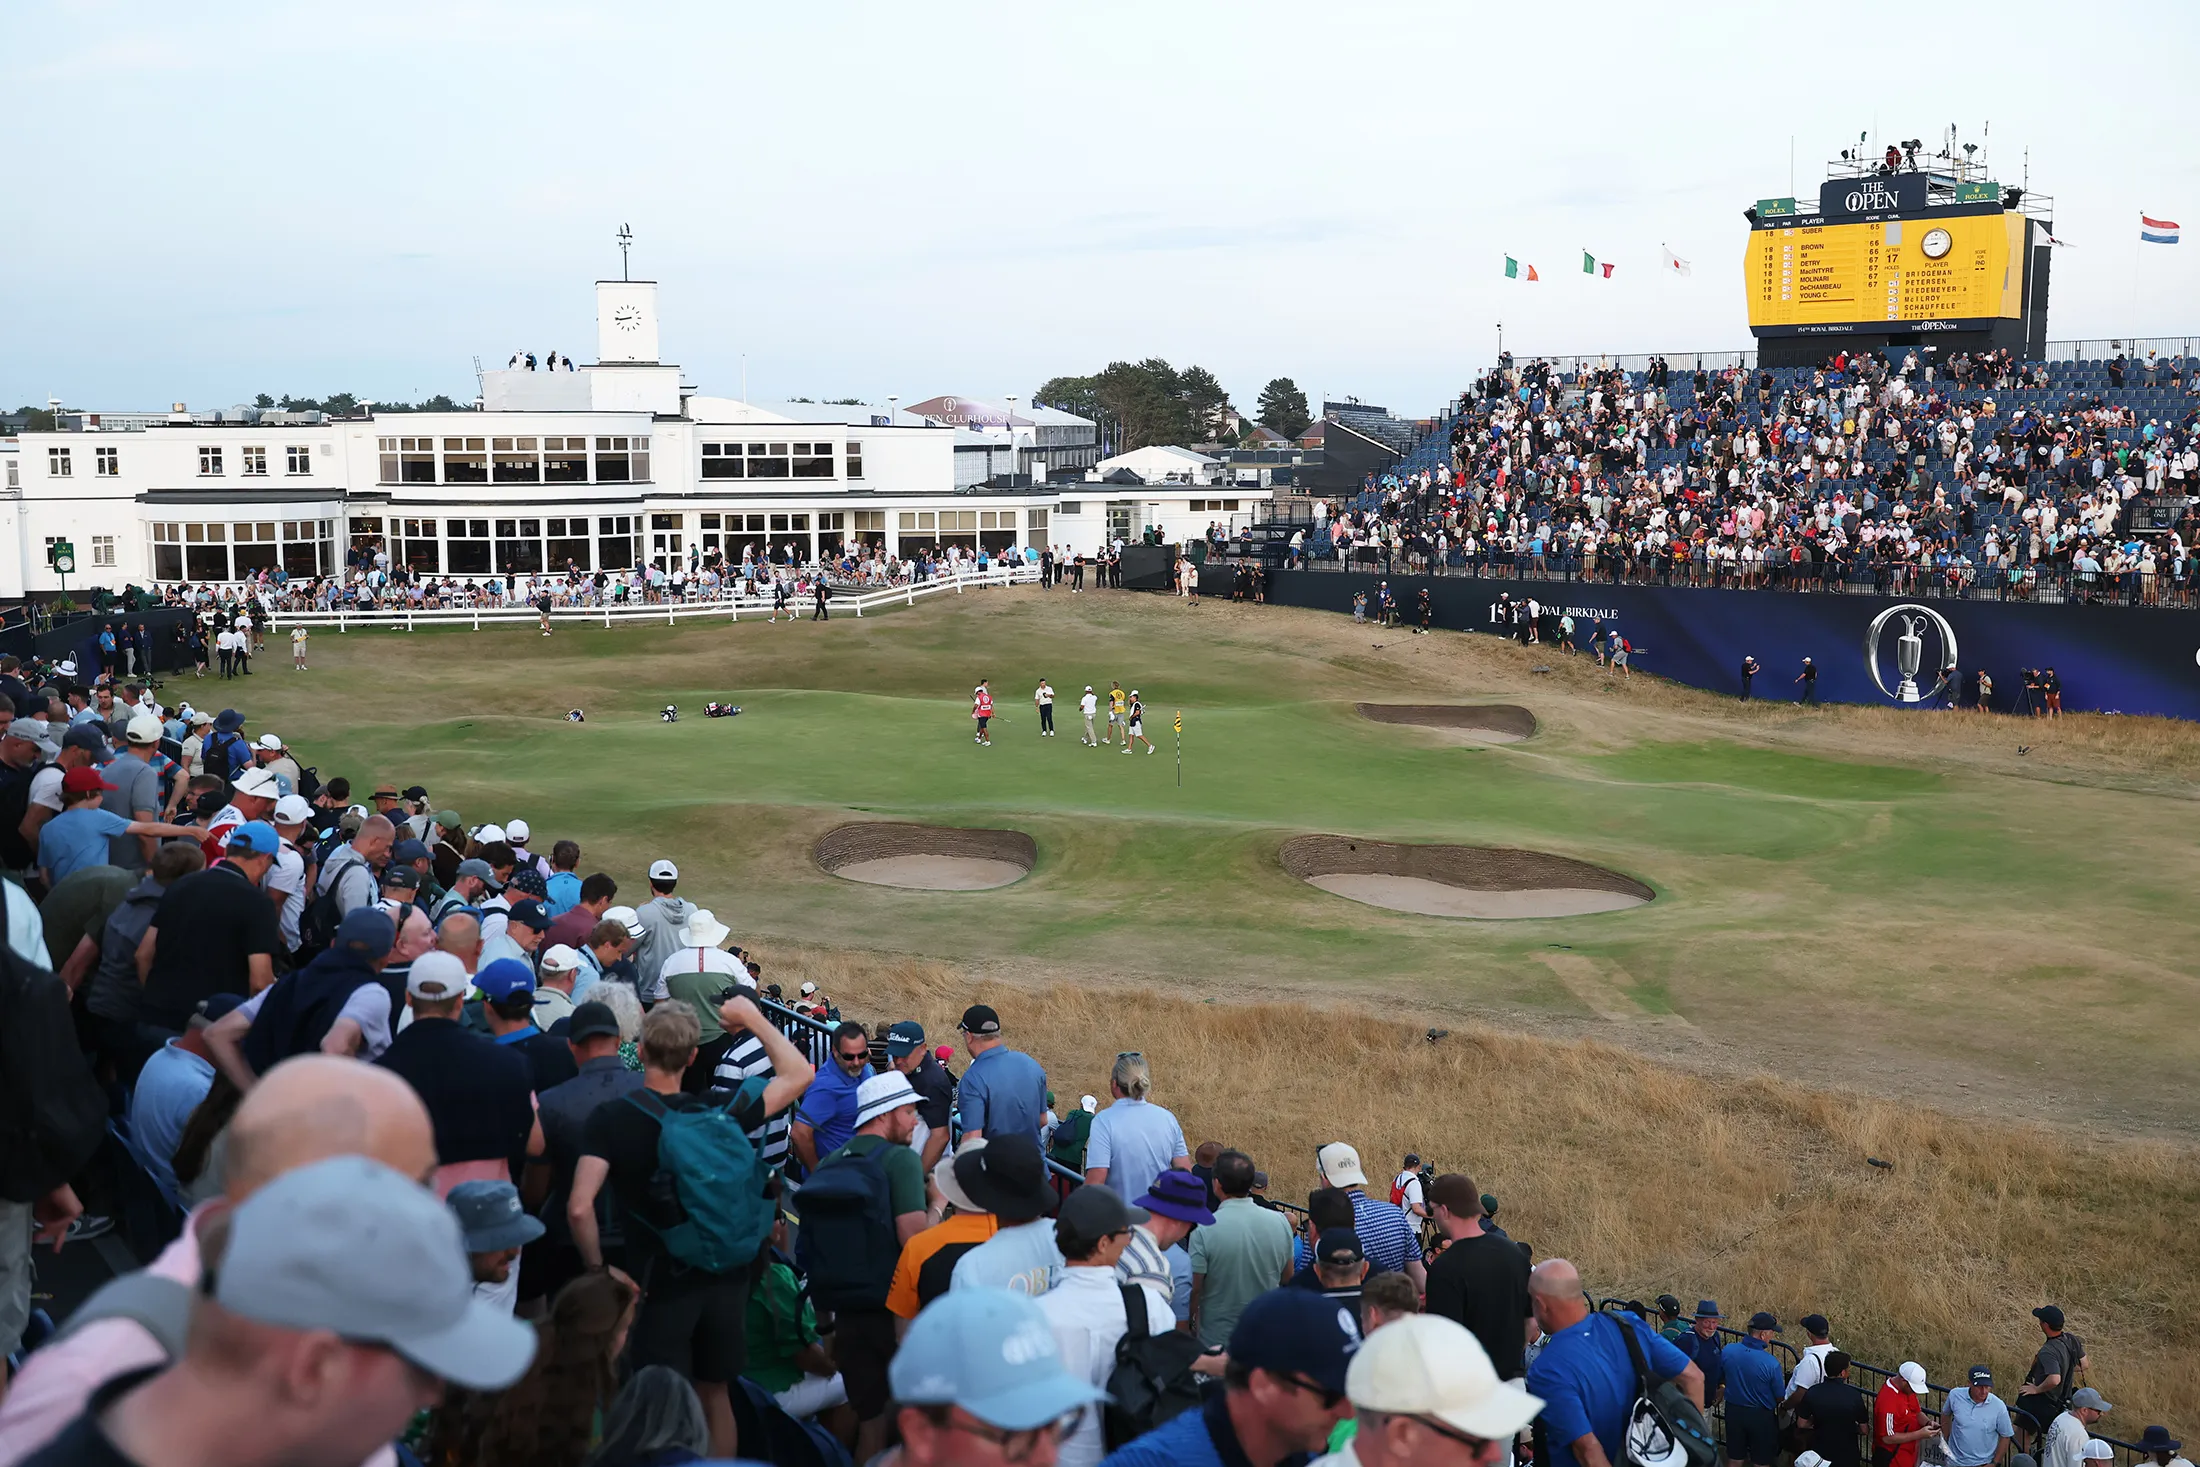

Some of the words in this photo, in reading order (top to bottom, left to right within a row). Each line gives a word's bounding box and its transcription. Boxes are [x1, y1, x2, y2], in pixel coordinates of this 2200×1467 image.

[1861, 181, 1884, 193] THE
[1845, 190, 1899, 212] OPEN
[1887, 254, 1898, 263] 17
[1905, 286, 1956, 294] WIEDEMEYER
[946, 414, 1009, 424] CLUBHOUSE
[1566, 606, 1618, 620] BIRKDALE
